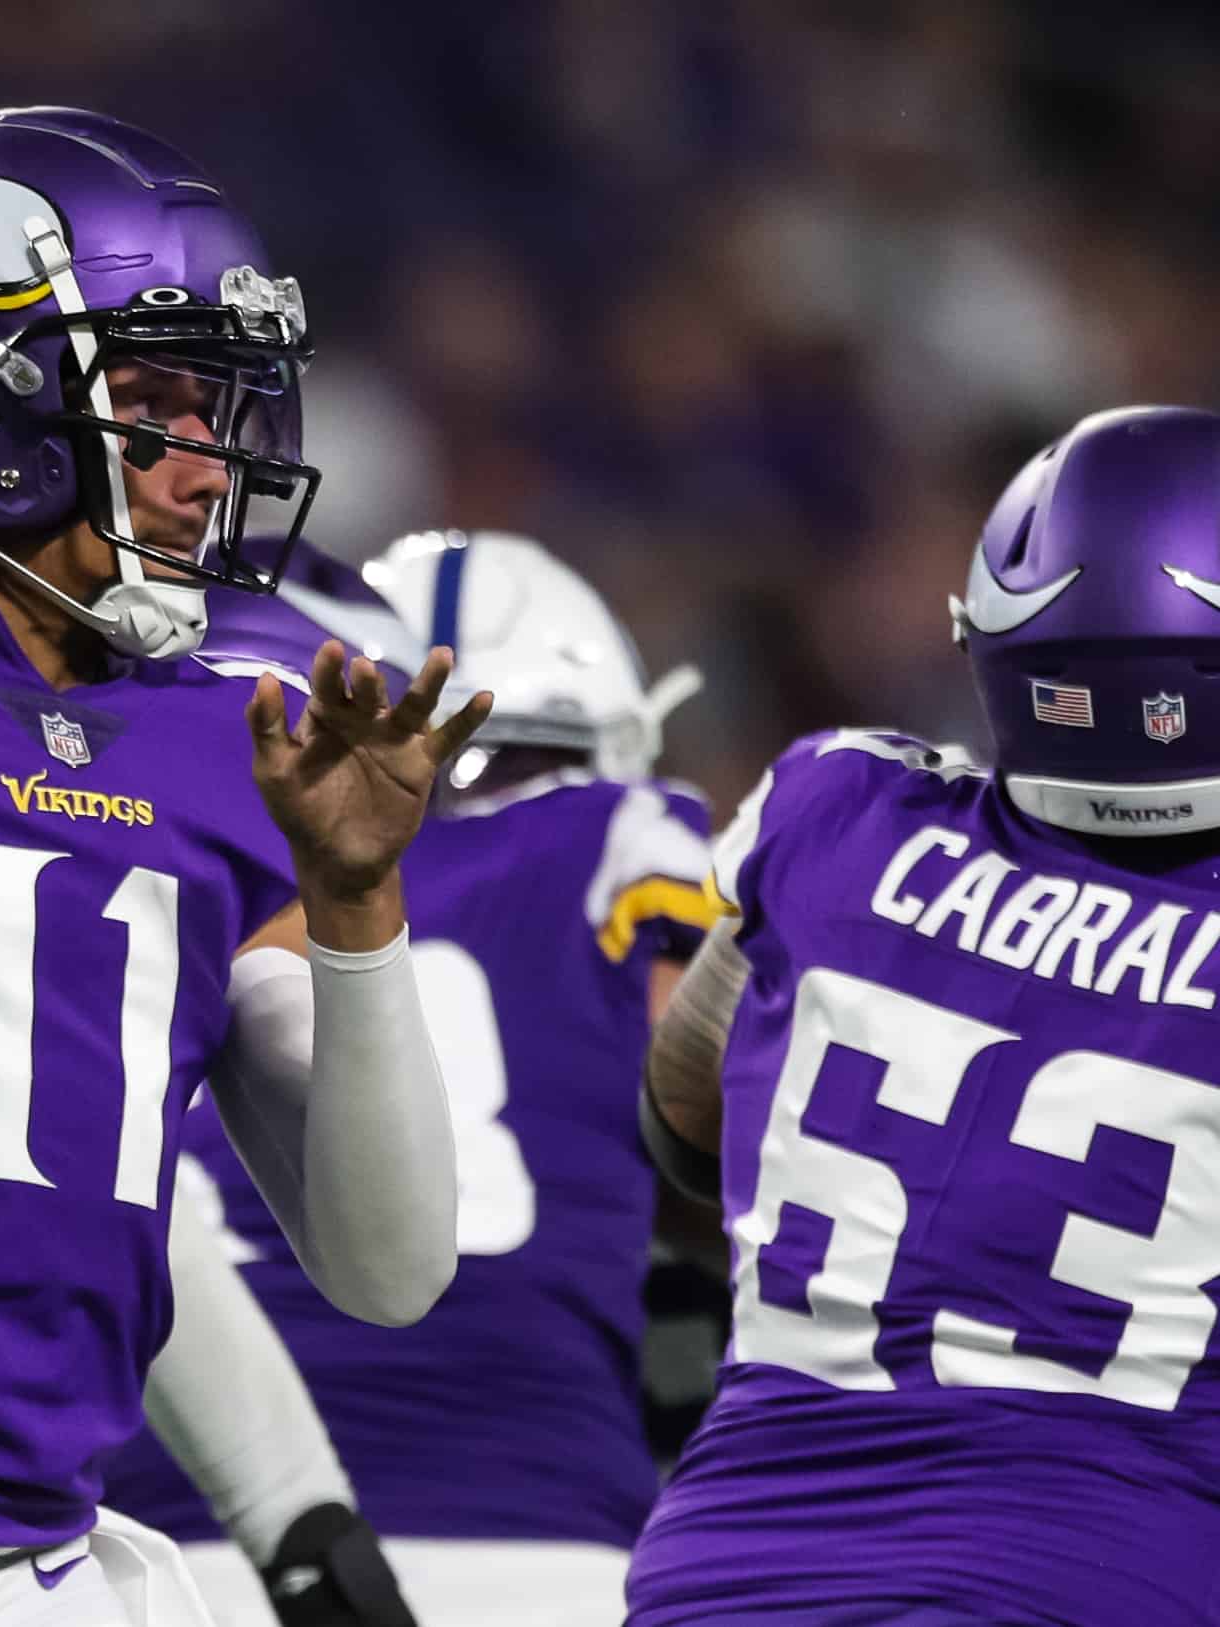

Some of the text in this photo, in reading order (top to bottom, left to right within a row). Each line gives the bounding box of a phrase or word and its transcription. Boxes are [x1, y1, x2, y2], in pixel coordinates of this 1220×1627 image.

[51, 735, 85, 757] NFL
[1148, 714, 1180, 735] NFL
[871, 826, 1220, 1009] CABRAL
[732, 967, 1220, 1411] 63
